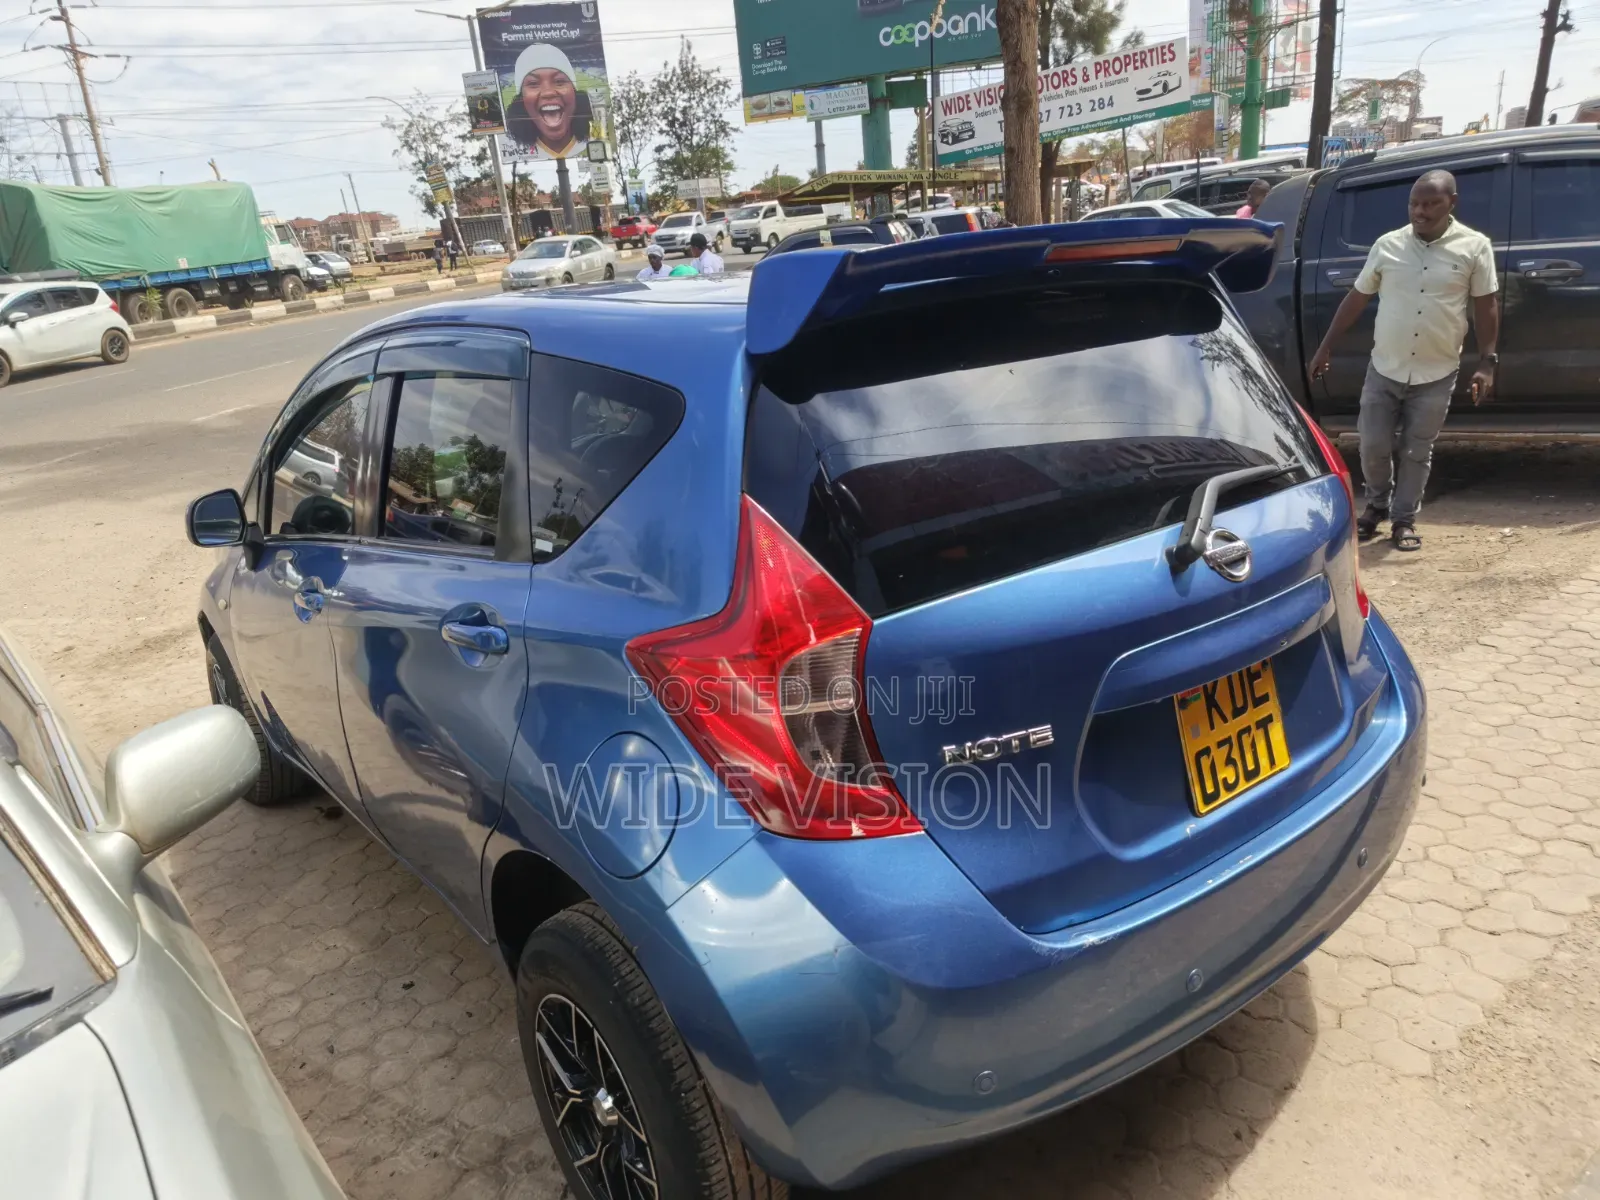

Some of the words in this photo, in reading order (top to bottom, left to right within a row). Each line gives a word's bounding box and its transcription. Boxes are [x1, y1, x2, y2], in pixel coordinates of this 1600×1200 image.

[534, 29, 559, 40] World
[561, 28, 580, 39] Cup!
[825, 88, 866, 99] MAGNATE
[941, 94, 972, 116] WIDE
[973, 84, 1005, 108] VISIO
[1037, 67, 1078, 95] OTORS
[1081, 66, 1090, 83] &
[1094, 43, 1176, 80] PROPERTIES
[1058, 102, 1082, 120] 723
[1088, 95, 1114, 113] 284
[810, 178, 831, 191] ENG.
[837, 174, 872, 182] PATRICK
[1202, 664, 1271, 731] KDE
[942, 724, 1055, 766] NOTE
[1194, 713, 1276, 806] 030T
